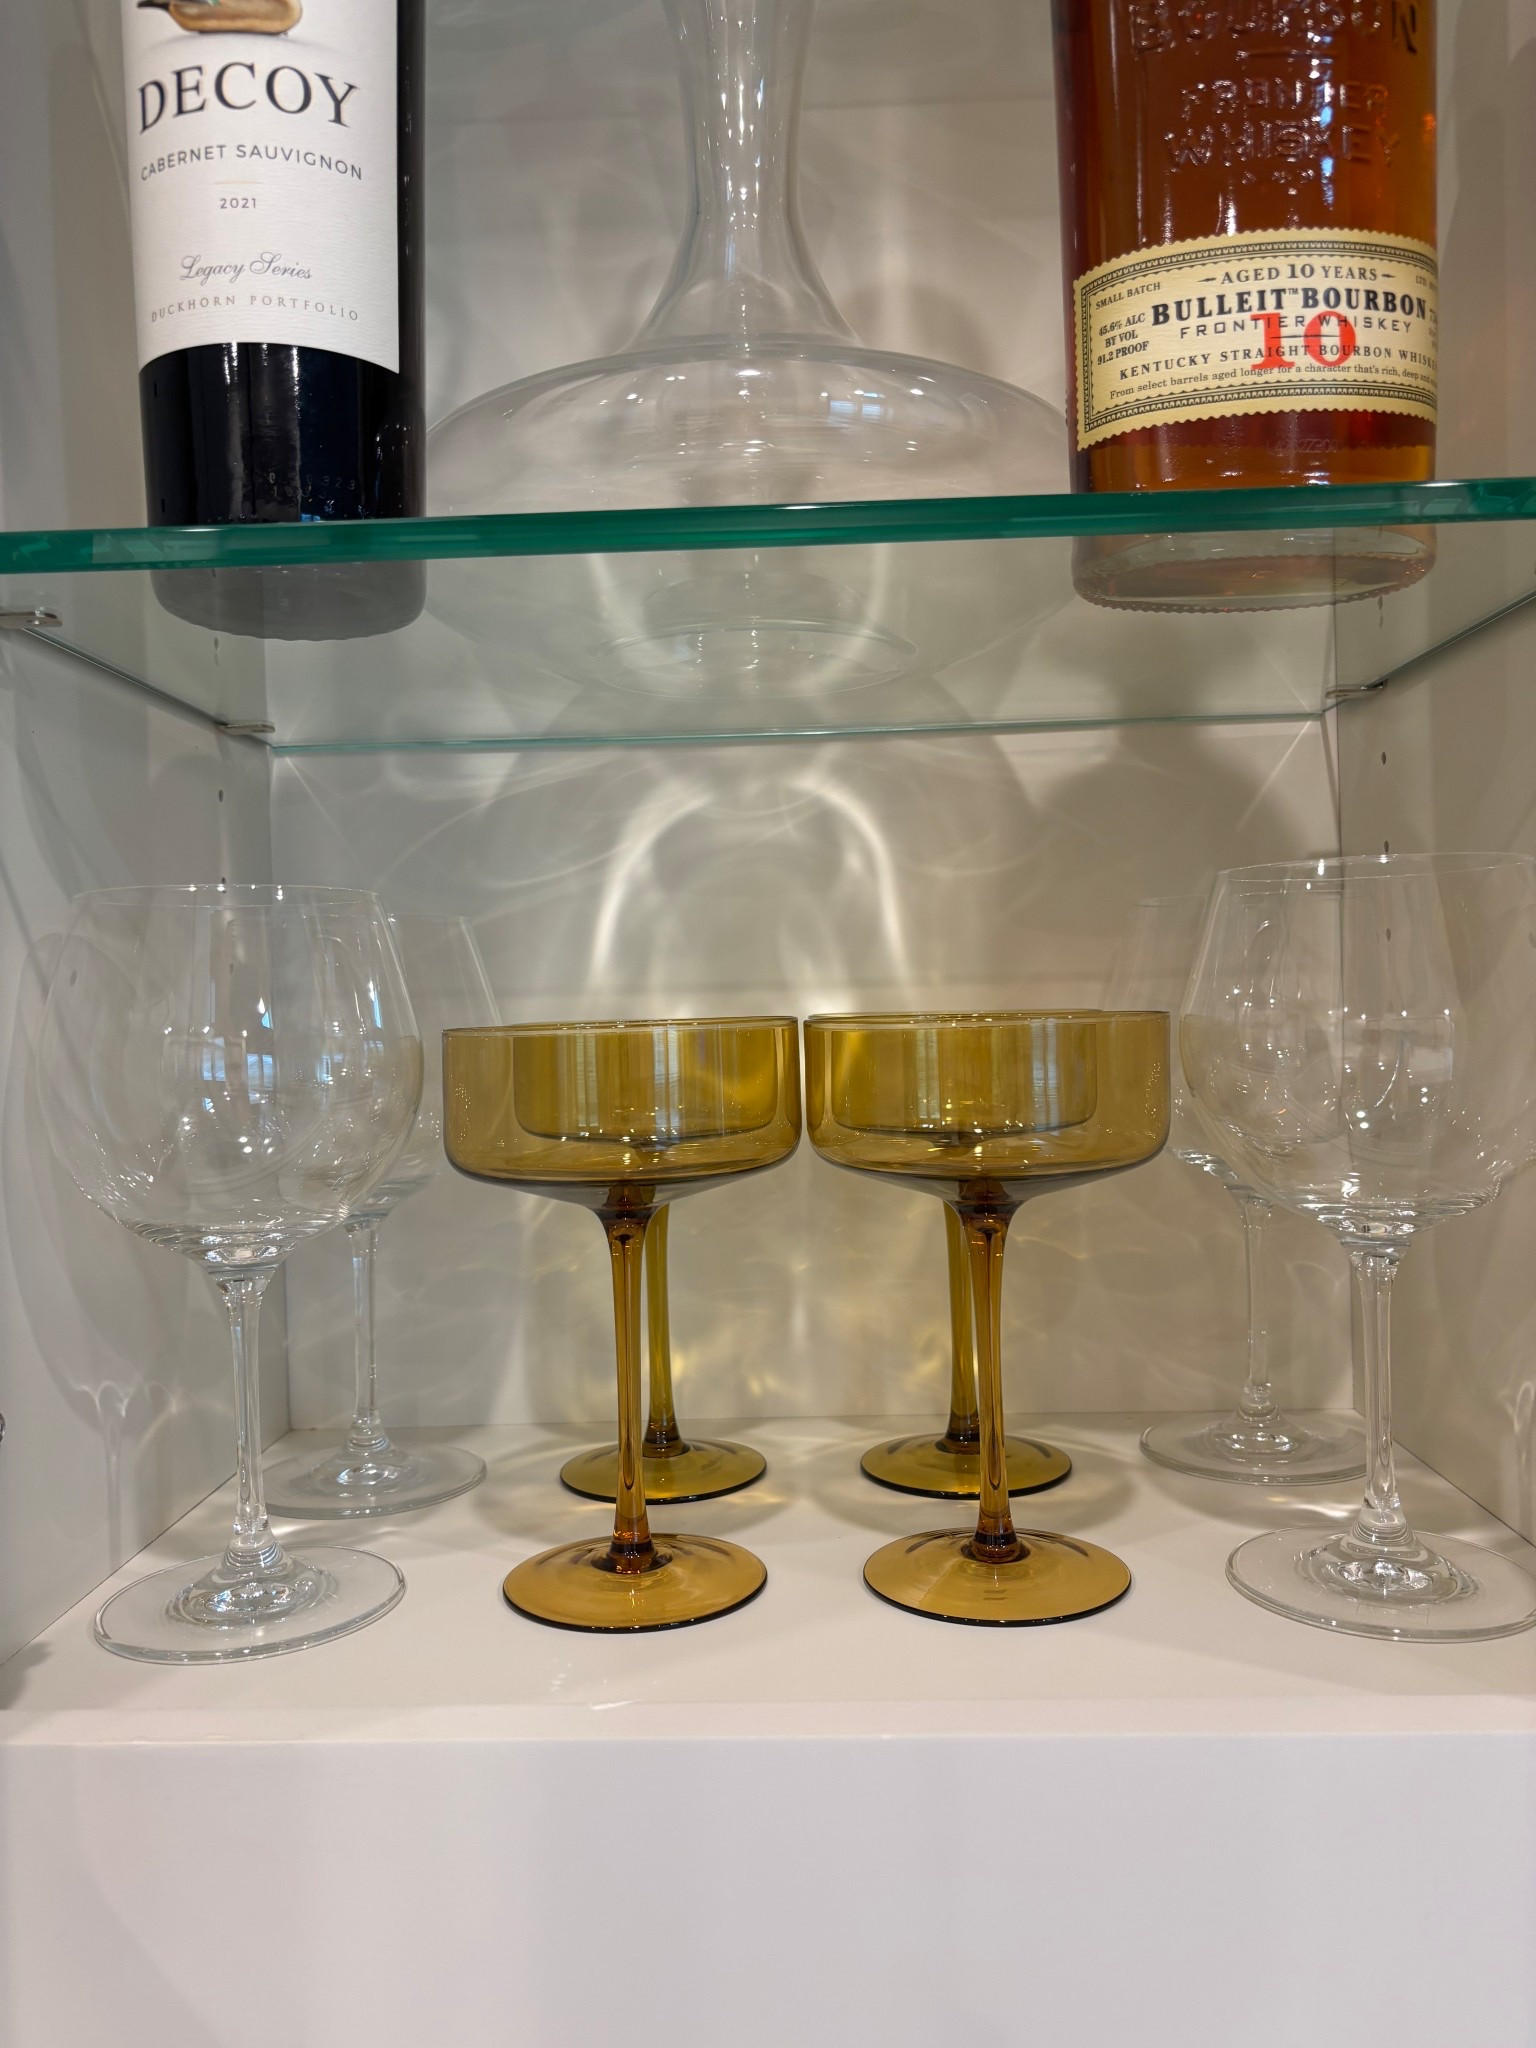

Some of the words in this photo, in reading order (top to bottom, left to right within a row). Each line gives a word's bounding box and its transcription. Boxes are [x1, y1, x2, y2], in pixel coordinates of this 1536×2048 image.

[137, 61, 360, 135] DECOY
[141, 144, 227, 181] CABERNET
[236, 144, 363, 181] SAUVIGNON
[220, 198, 257, 210] 2021
[179, 254, 245, 287] Legacy
[249, 251, 312, 280] Series
[1221, 267, 1280, 285] AGED
[1287, 263, 1315, 279] 10
[1320, 265, 1378, 281] YEARS
[151, 295, 236, 322] DUCKHORN
[250, 295, 358, 321] PORTFOLIO
[1095, 293, 1124, 310] SMALL
[1127, 282, 1161, 298] BATCH
[1301, 287, 1426, 321] BOURBON
[1124, 312, 1146, 328] ALC
[1180, 315, 1305, 339] FRONTIER
[1318, 315, 1412, 333] WHISKEY
[1105, 335, 1117, 349] BY
[1118, 329, 1138, 343] VOL
[1115, 341, 1150, 360] PROOF
[1250, 310, 1357, 370] 10
[1119, 353, 1211, 381] KENTUCKY
[1219, 344, 1310, 363] STRAIGHT
[1318, 344, 1392, 359] BOURBON
[1110, 386, 1135, 400] From
[1137, 379, 1168, 392] select
[1170, 372, 1209, 387] barrels
[1211, 369, 1237, 381] aged
[1240, 365, 1274, 378] longer
[1277, 364, 1292, 374] for
[1304, 363, 1351, 374] character
[1354, 363, 1379, 375] that's
[1381, 366, 1401, 378] rich,
[1402, 369, 1419, 382] deep
